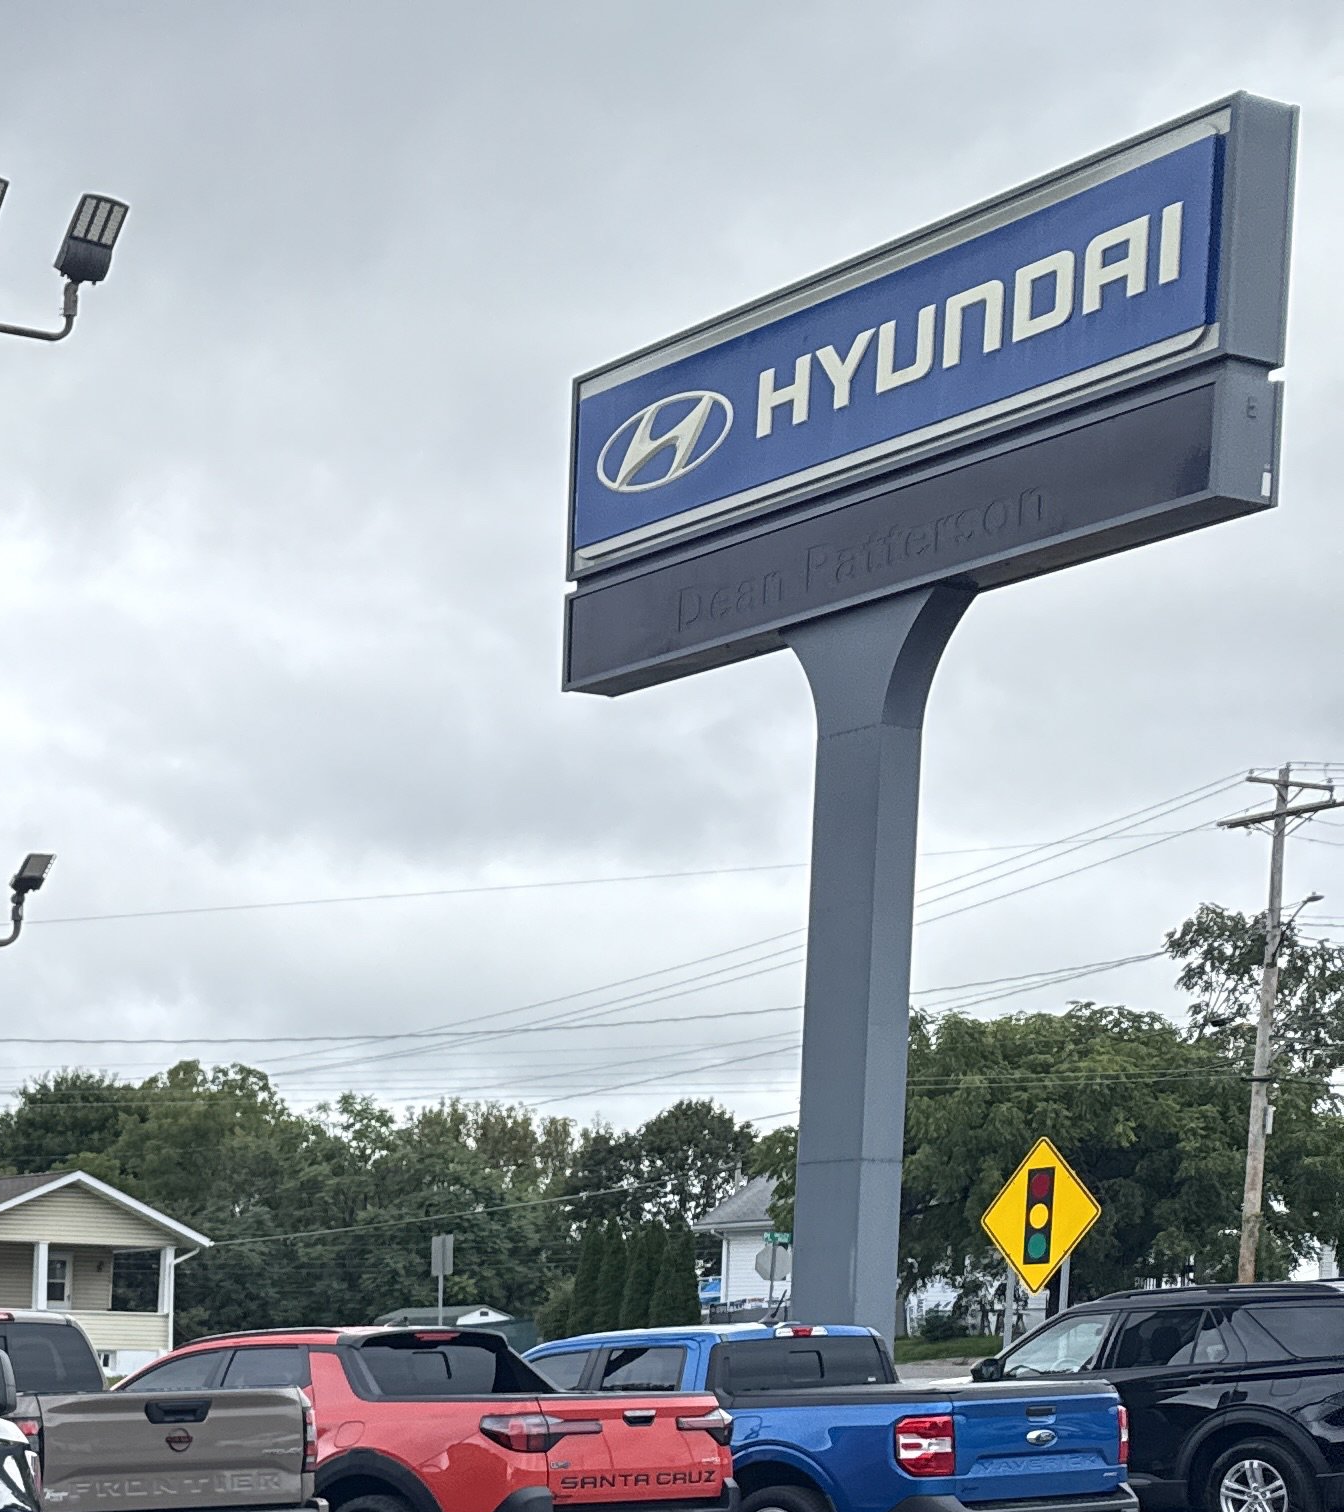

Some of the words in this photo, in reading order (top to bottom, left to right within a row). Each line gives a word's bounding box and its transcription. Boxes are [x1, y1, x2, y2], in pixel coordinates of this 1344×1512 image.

[756, 201, 1184, 439] HYUNDAI
[677, 569, 783, 632] Dean
[805, 486, 1042, 592] Patterson
[978, 1454, 1098, 1474] MAVERICK
[68, 1471, 282, 1499] FRONTIER
[561, 1473, 650, 1489] SANTA
[656, 1470, 716, 1485] CRUZ
